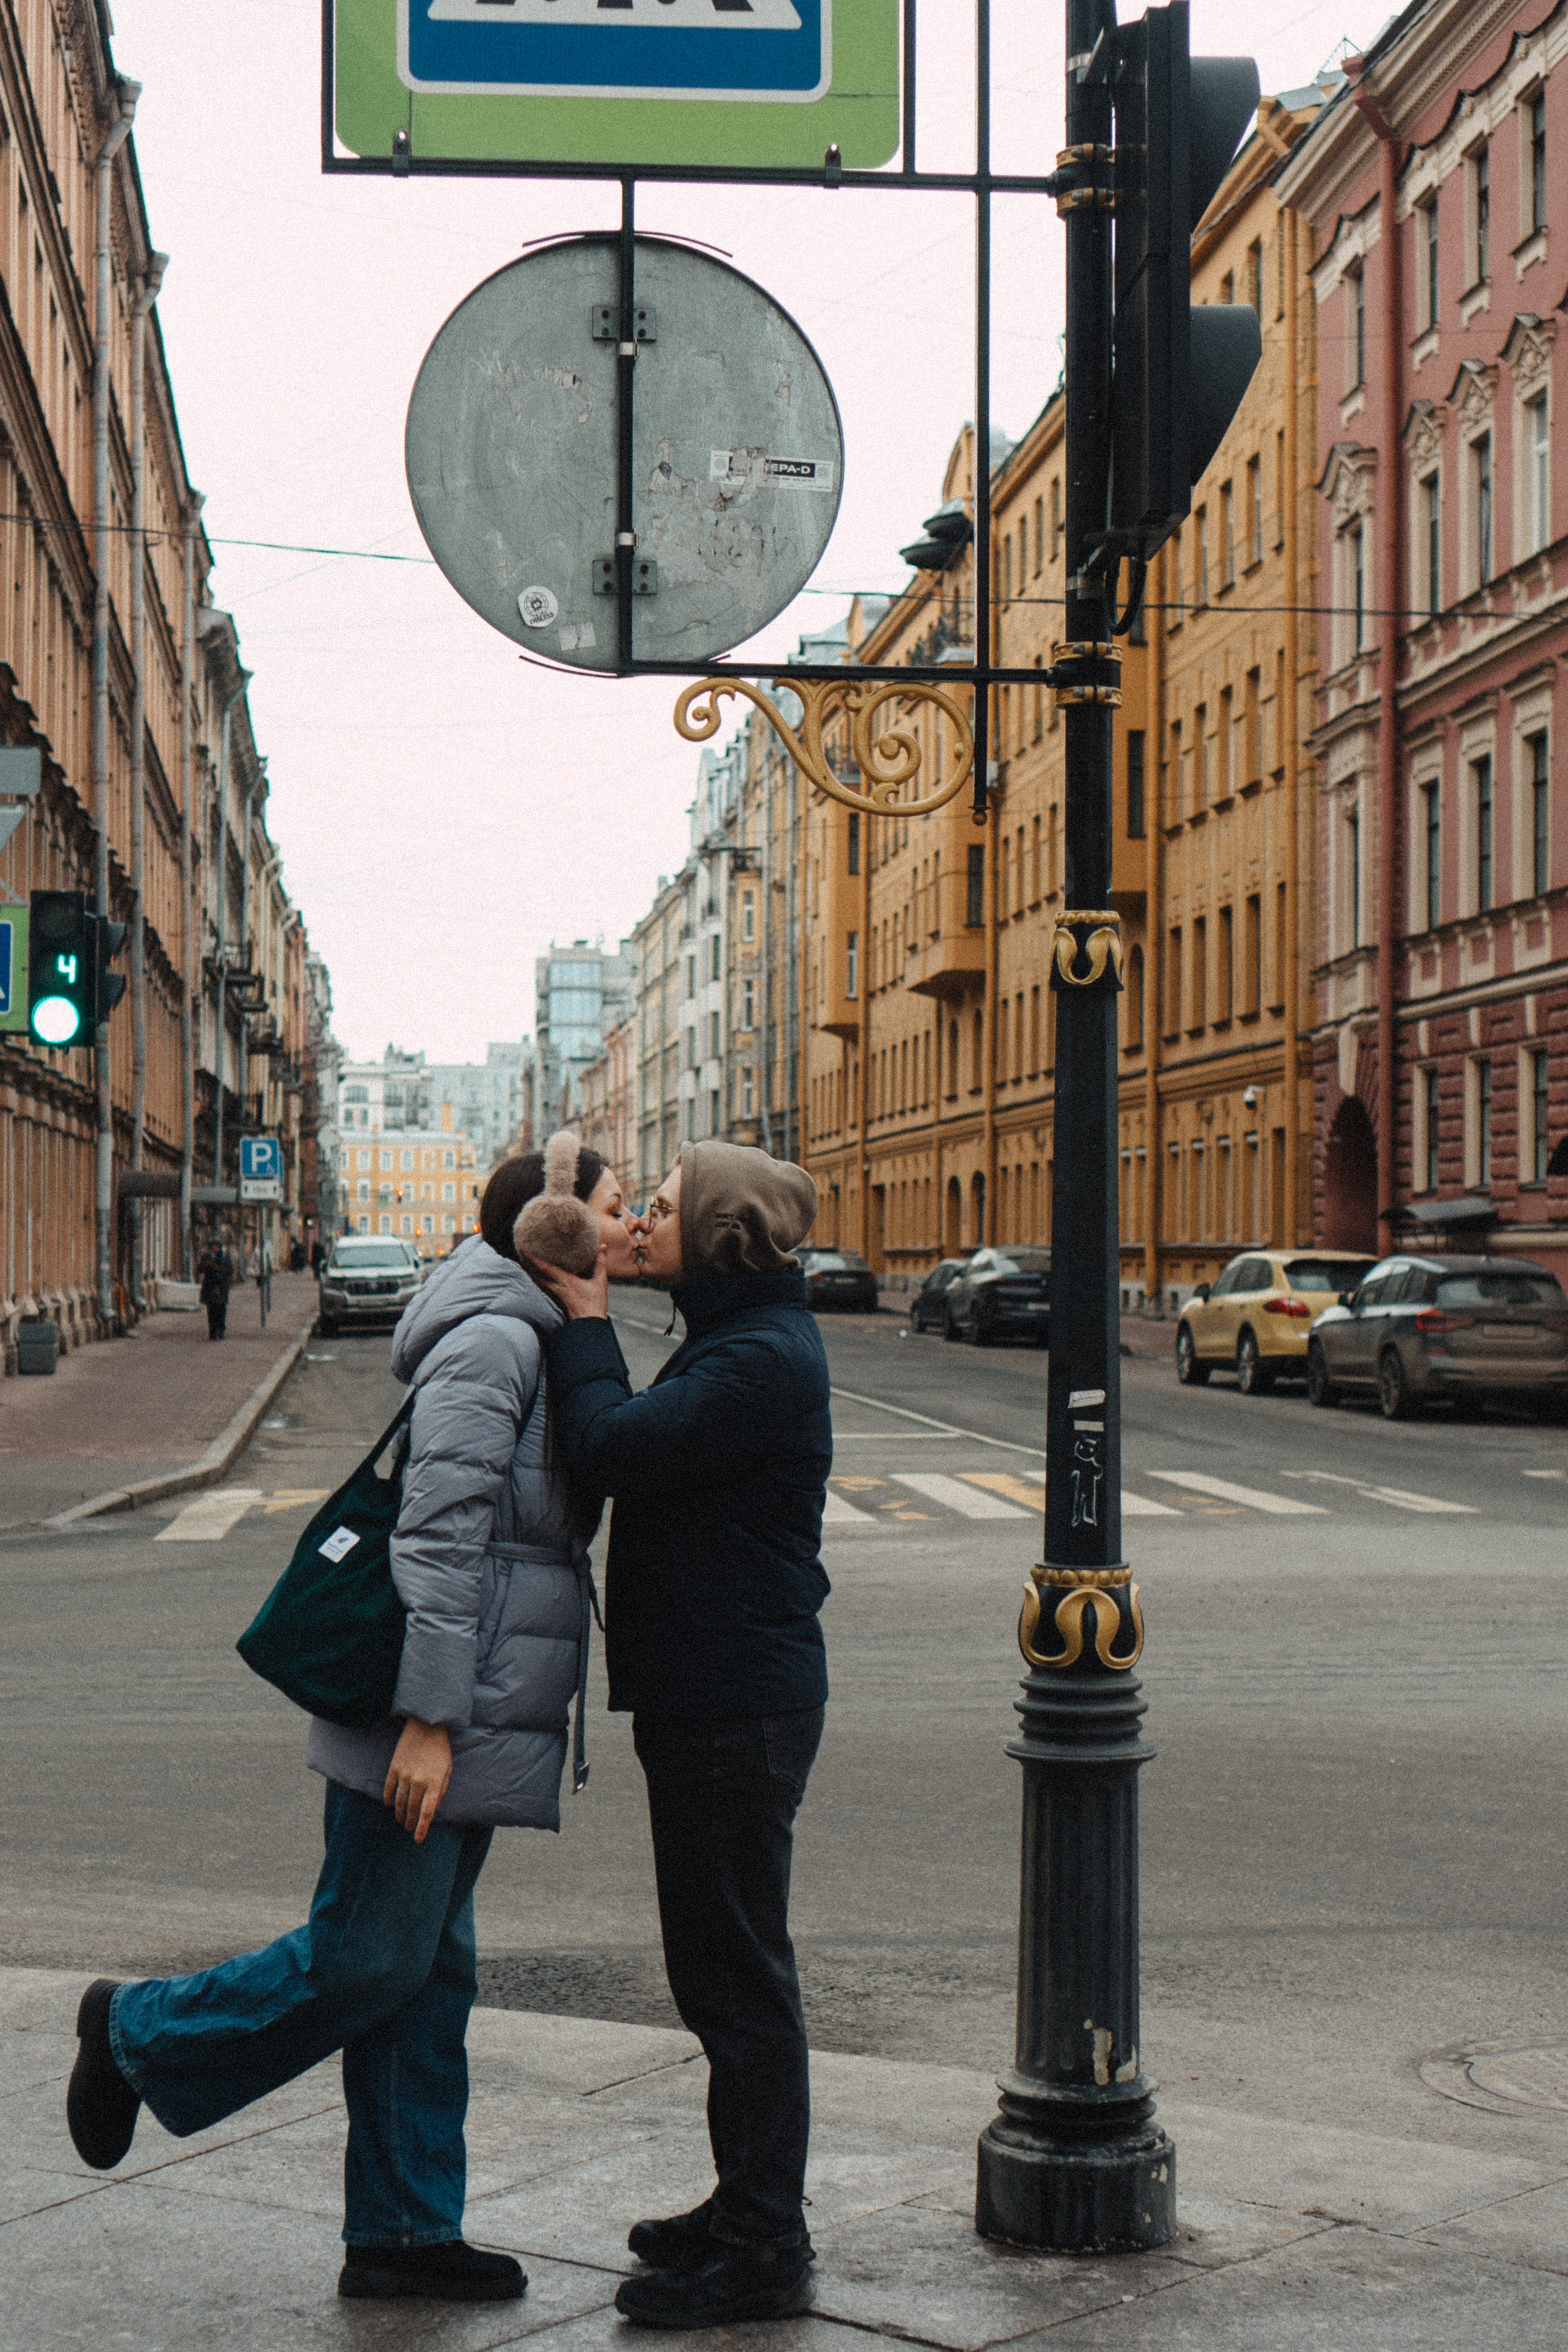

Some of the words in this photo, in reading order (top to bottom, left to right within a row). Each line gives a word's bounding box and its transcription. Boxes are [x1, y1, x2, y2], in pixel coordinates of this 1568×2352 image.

[530, 611, 554, 624] ENDLESS
[58, 954, 77, 984] 4
[251, 1142, 272, 1172] P
